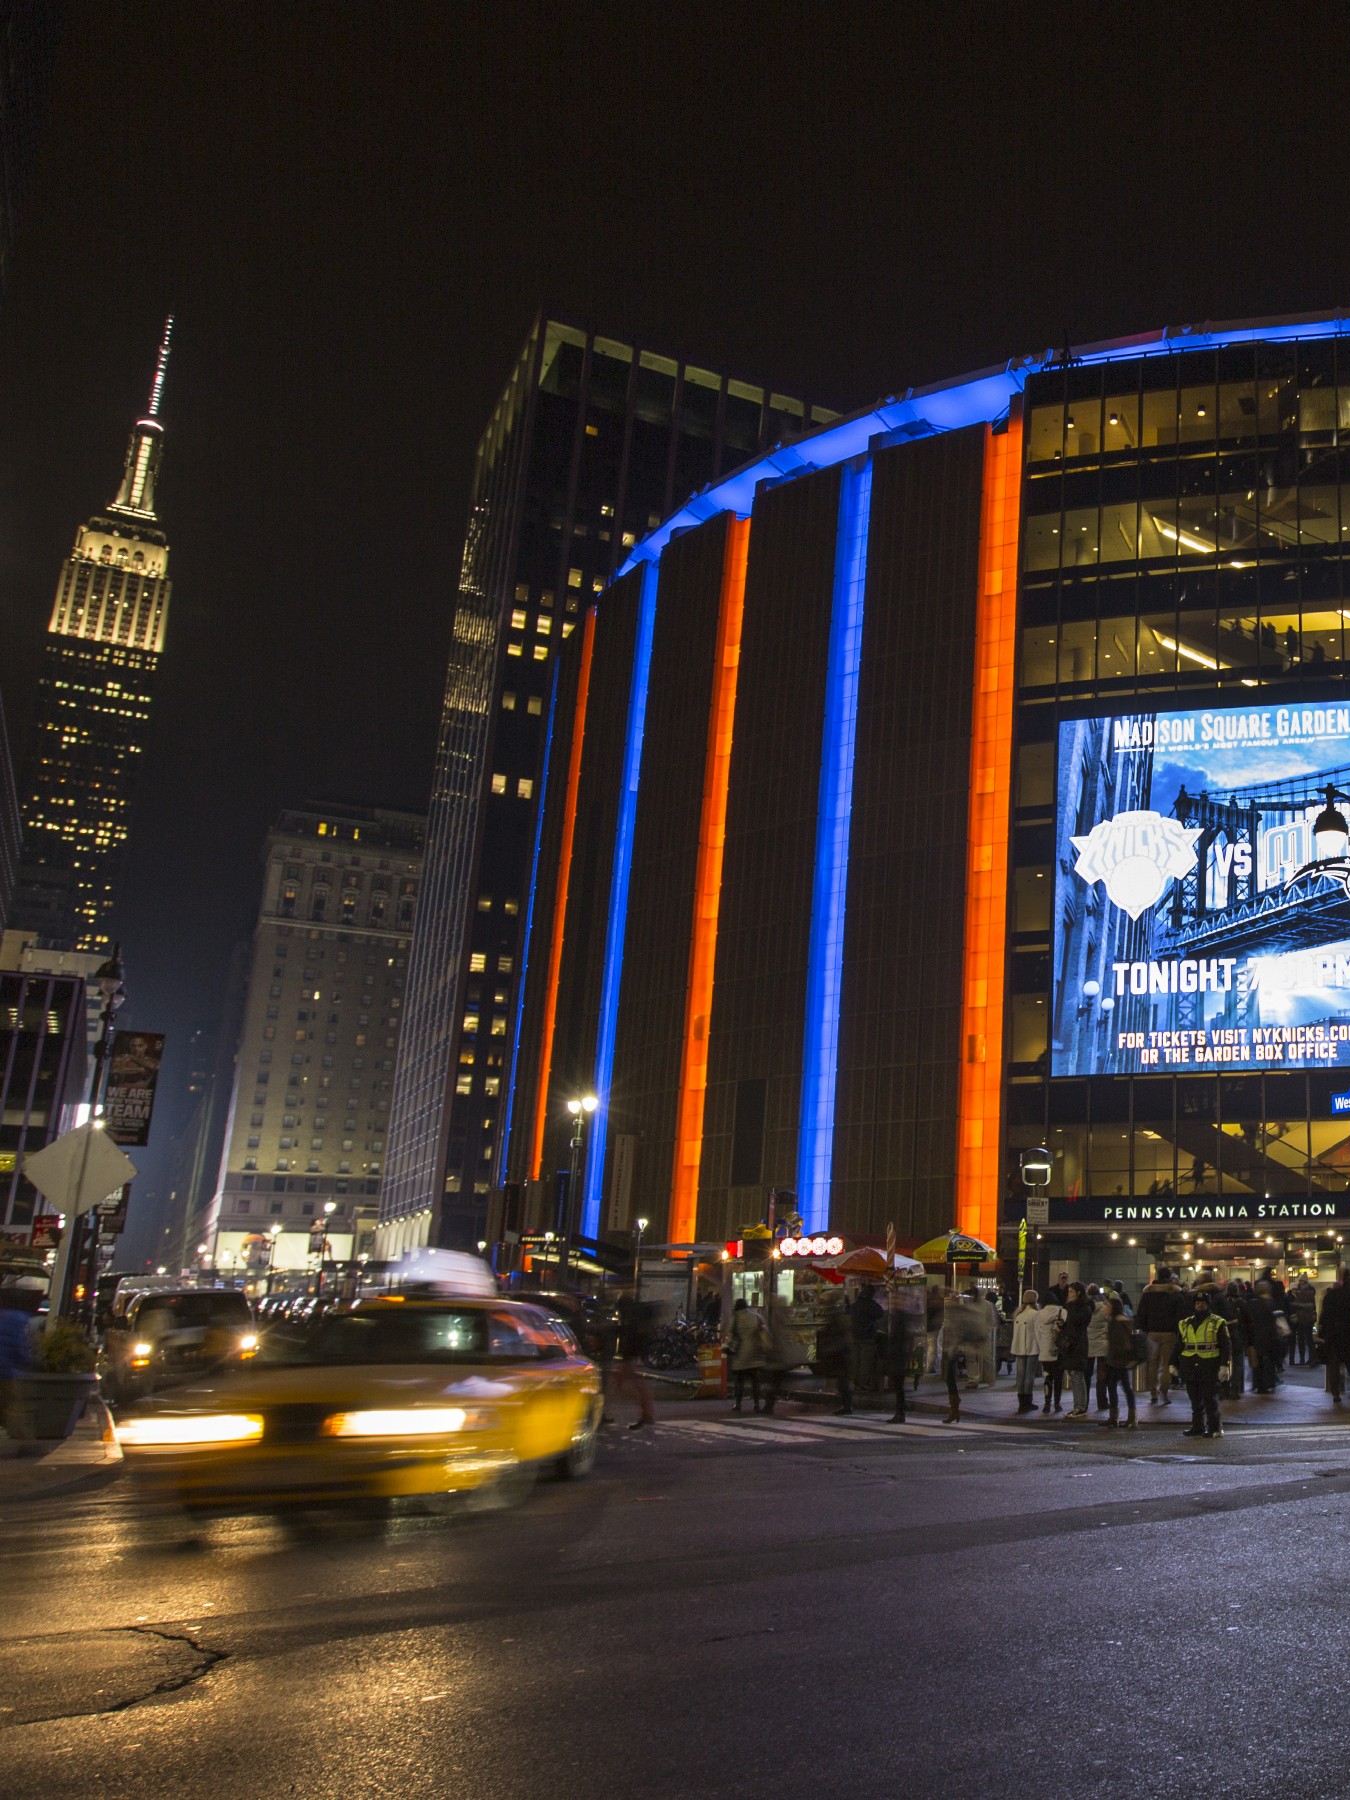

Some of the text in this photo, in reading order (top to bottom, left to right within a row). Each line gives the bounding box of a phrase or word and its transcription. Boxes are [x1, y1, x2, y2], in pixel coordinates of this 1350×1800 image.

[1114, 718, 1195, 748] MADISON
[1201, 712, 1271, 742] SQUARE
[1168, 743, 1209, 752] WORLD'S
[1212, 740, 1238, 749] MOST
[1241, 739, 1279, 748] FAMOUS
[1089, 821, 1184, 871] KNICKS
[1215, 843, 1252, 877] VS
[1112, 957, 1237, 996] TONIGHT
[1118, 1032, 1144, 1049] FOR
[1148, 1030, 1206, 1047] TICKETS
[1211, 1028, 1247, 1045] VISIT
[1141, 1042, 1338, 1064] OR THE GARDEN BOX OFFICE
[107, 1086, 153, 1100] WE ARE
[105, 1104, 150, 1119] TEAM
[1104, 1203, 1336, 1219] PENNSYLVANIA STATION
